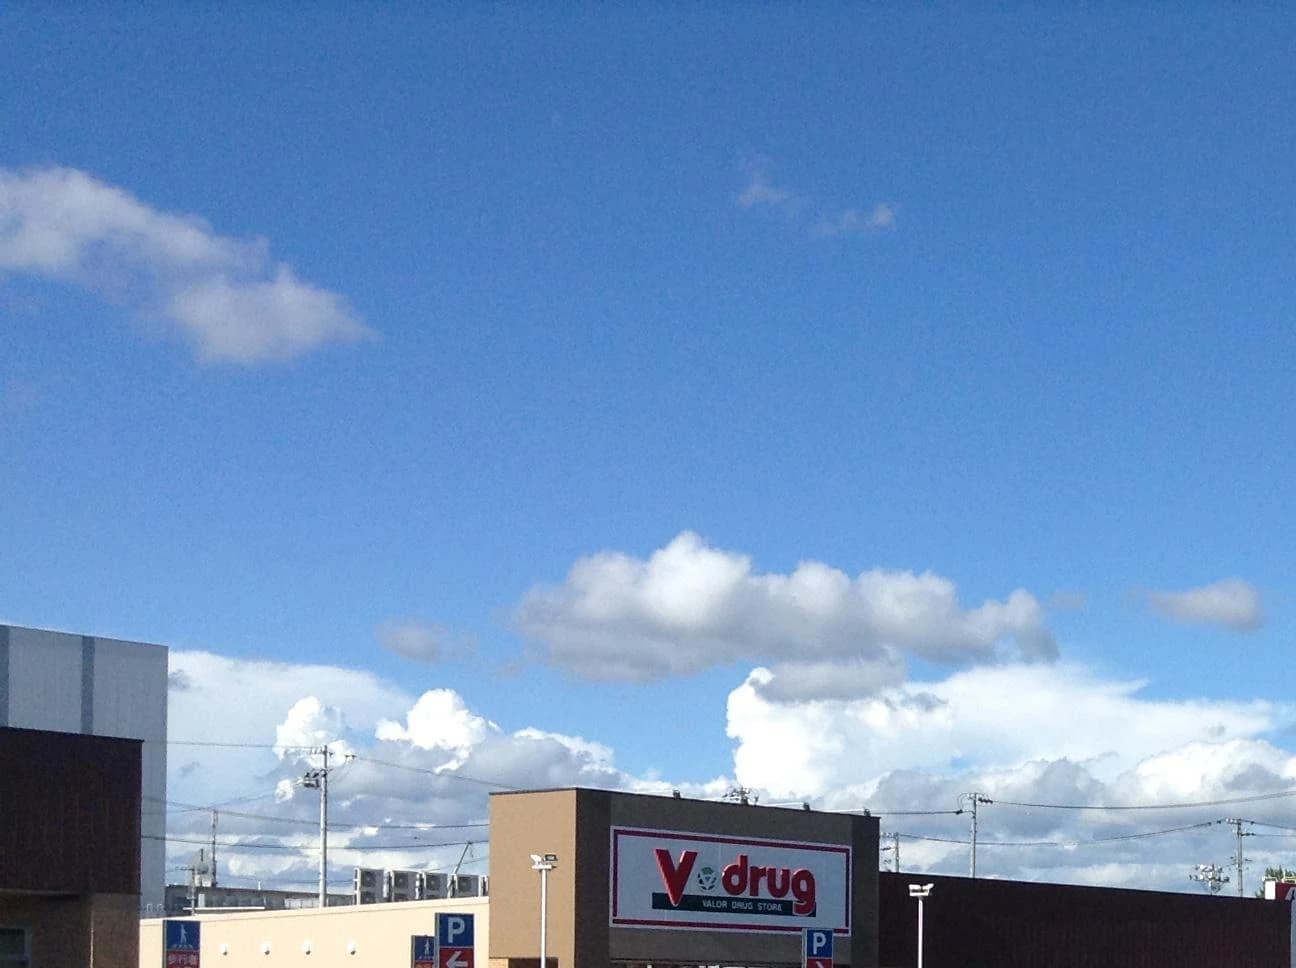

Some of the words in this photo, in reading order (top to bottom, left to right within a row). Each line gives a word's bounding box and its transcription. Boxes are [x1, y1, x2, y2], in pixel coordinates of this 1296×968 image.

[655, 848, 698, 907] V
[722, 854, 817, 916] drug
[702, 899, 728, 909] VALOR
[731, 901, 753, 910] DRUG
[447, 916, 465, 943] P
[813, 932, 826, 955] P
